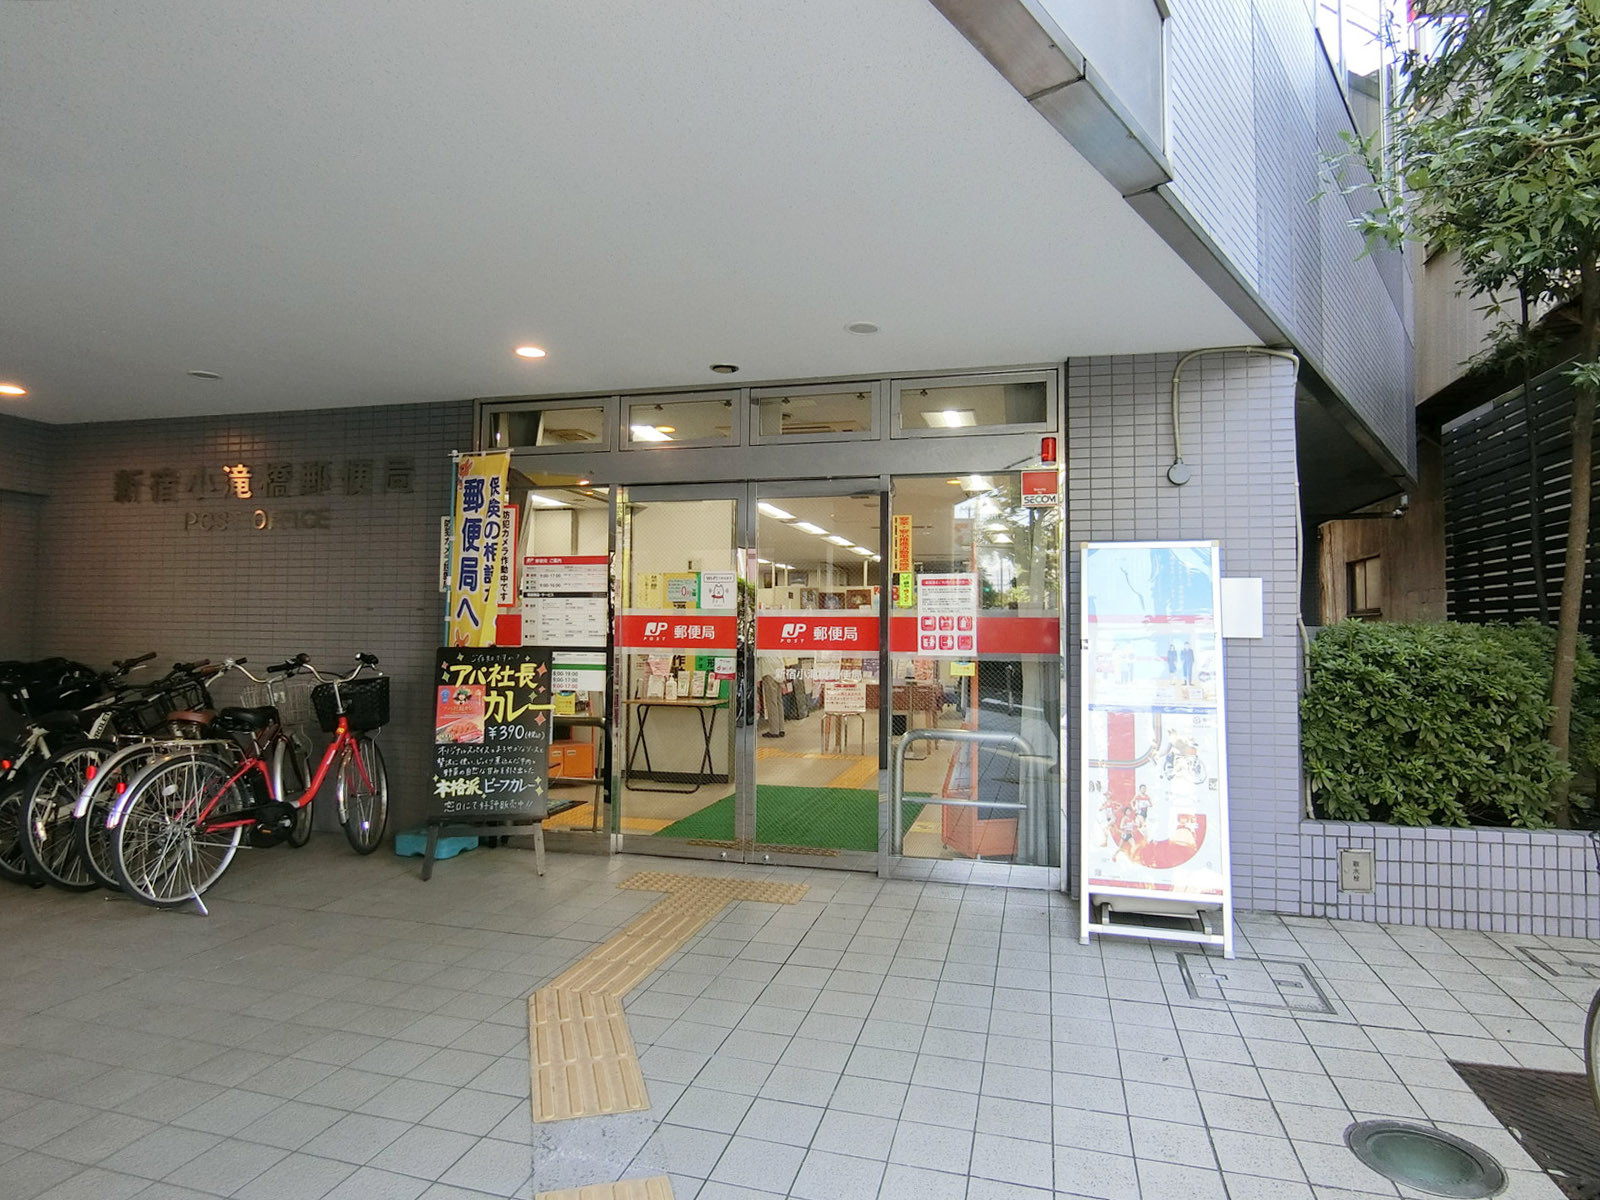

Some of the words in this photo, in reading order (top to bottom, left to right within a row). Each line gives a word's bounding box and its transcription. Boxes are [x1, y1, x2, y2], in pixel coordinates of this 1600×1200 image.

[113, 455, 415, 503] 新宿小滝橋郵便局
[1024, 495, 1056, 504] SECOM
[183, 510, 243, 531] POS
[456, 478, 485, 628] 郵便局へ
[499, 510, 511, 602] 防犯カメラ作動中です
[673, 624, 715, 640] 郵便局
[812, 626, 858, 641] 郵便局
[449, 662, 539, 689] アパ社長
[483, 691, 556, 724] カレー
